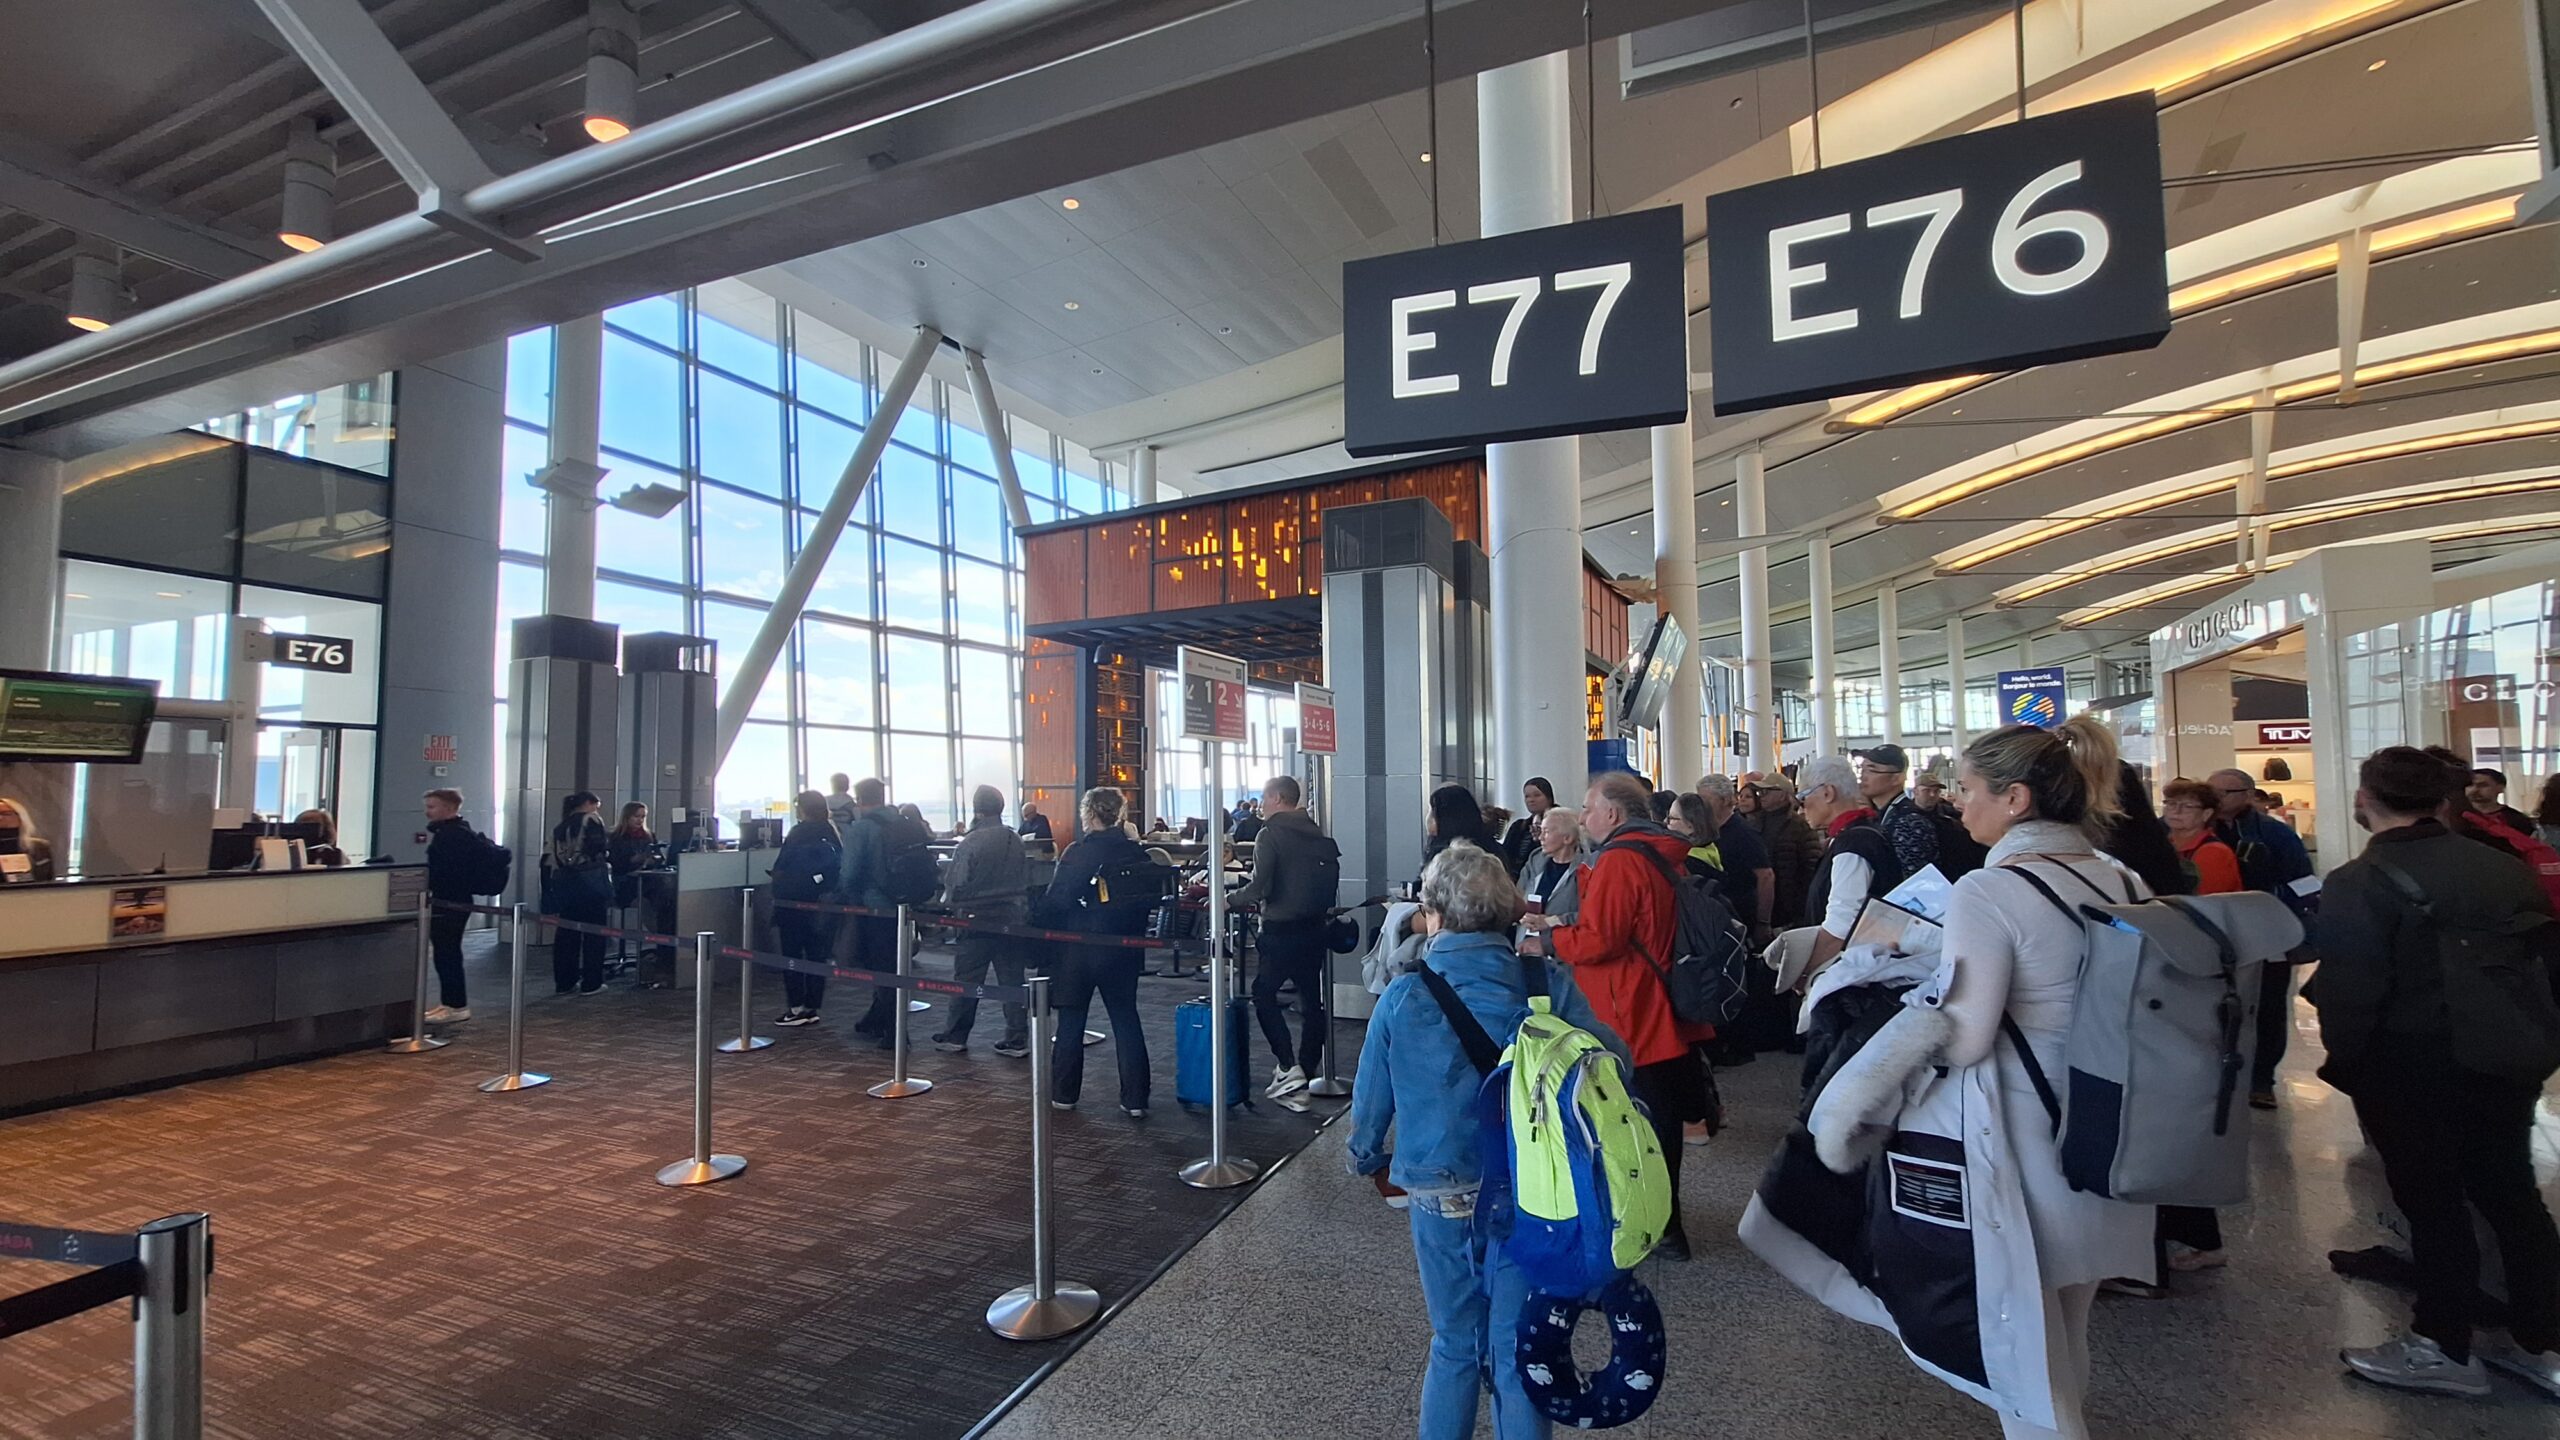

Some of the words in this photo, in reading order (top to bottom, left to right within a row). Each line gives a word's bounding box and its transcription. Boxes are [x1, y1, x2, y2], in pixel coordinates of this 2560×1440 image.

[1768, 159, 2110, 343] E76
[1391, 262, 1631, 399] E77
[2189, 599, 2249, 648] GUCCI
[288, 640, 344, 665] E76
[1205, 680, 1212, 703] 1
[1218, 682, 1228, 706] 2
[424, 747, 456, 762] SORTIE
